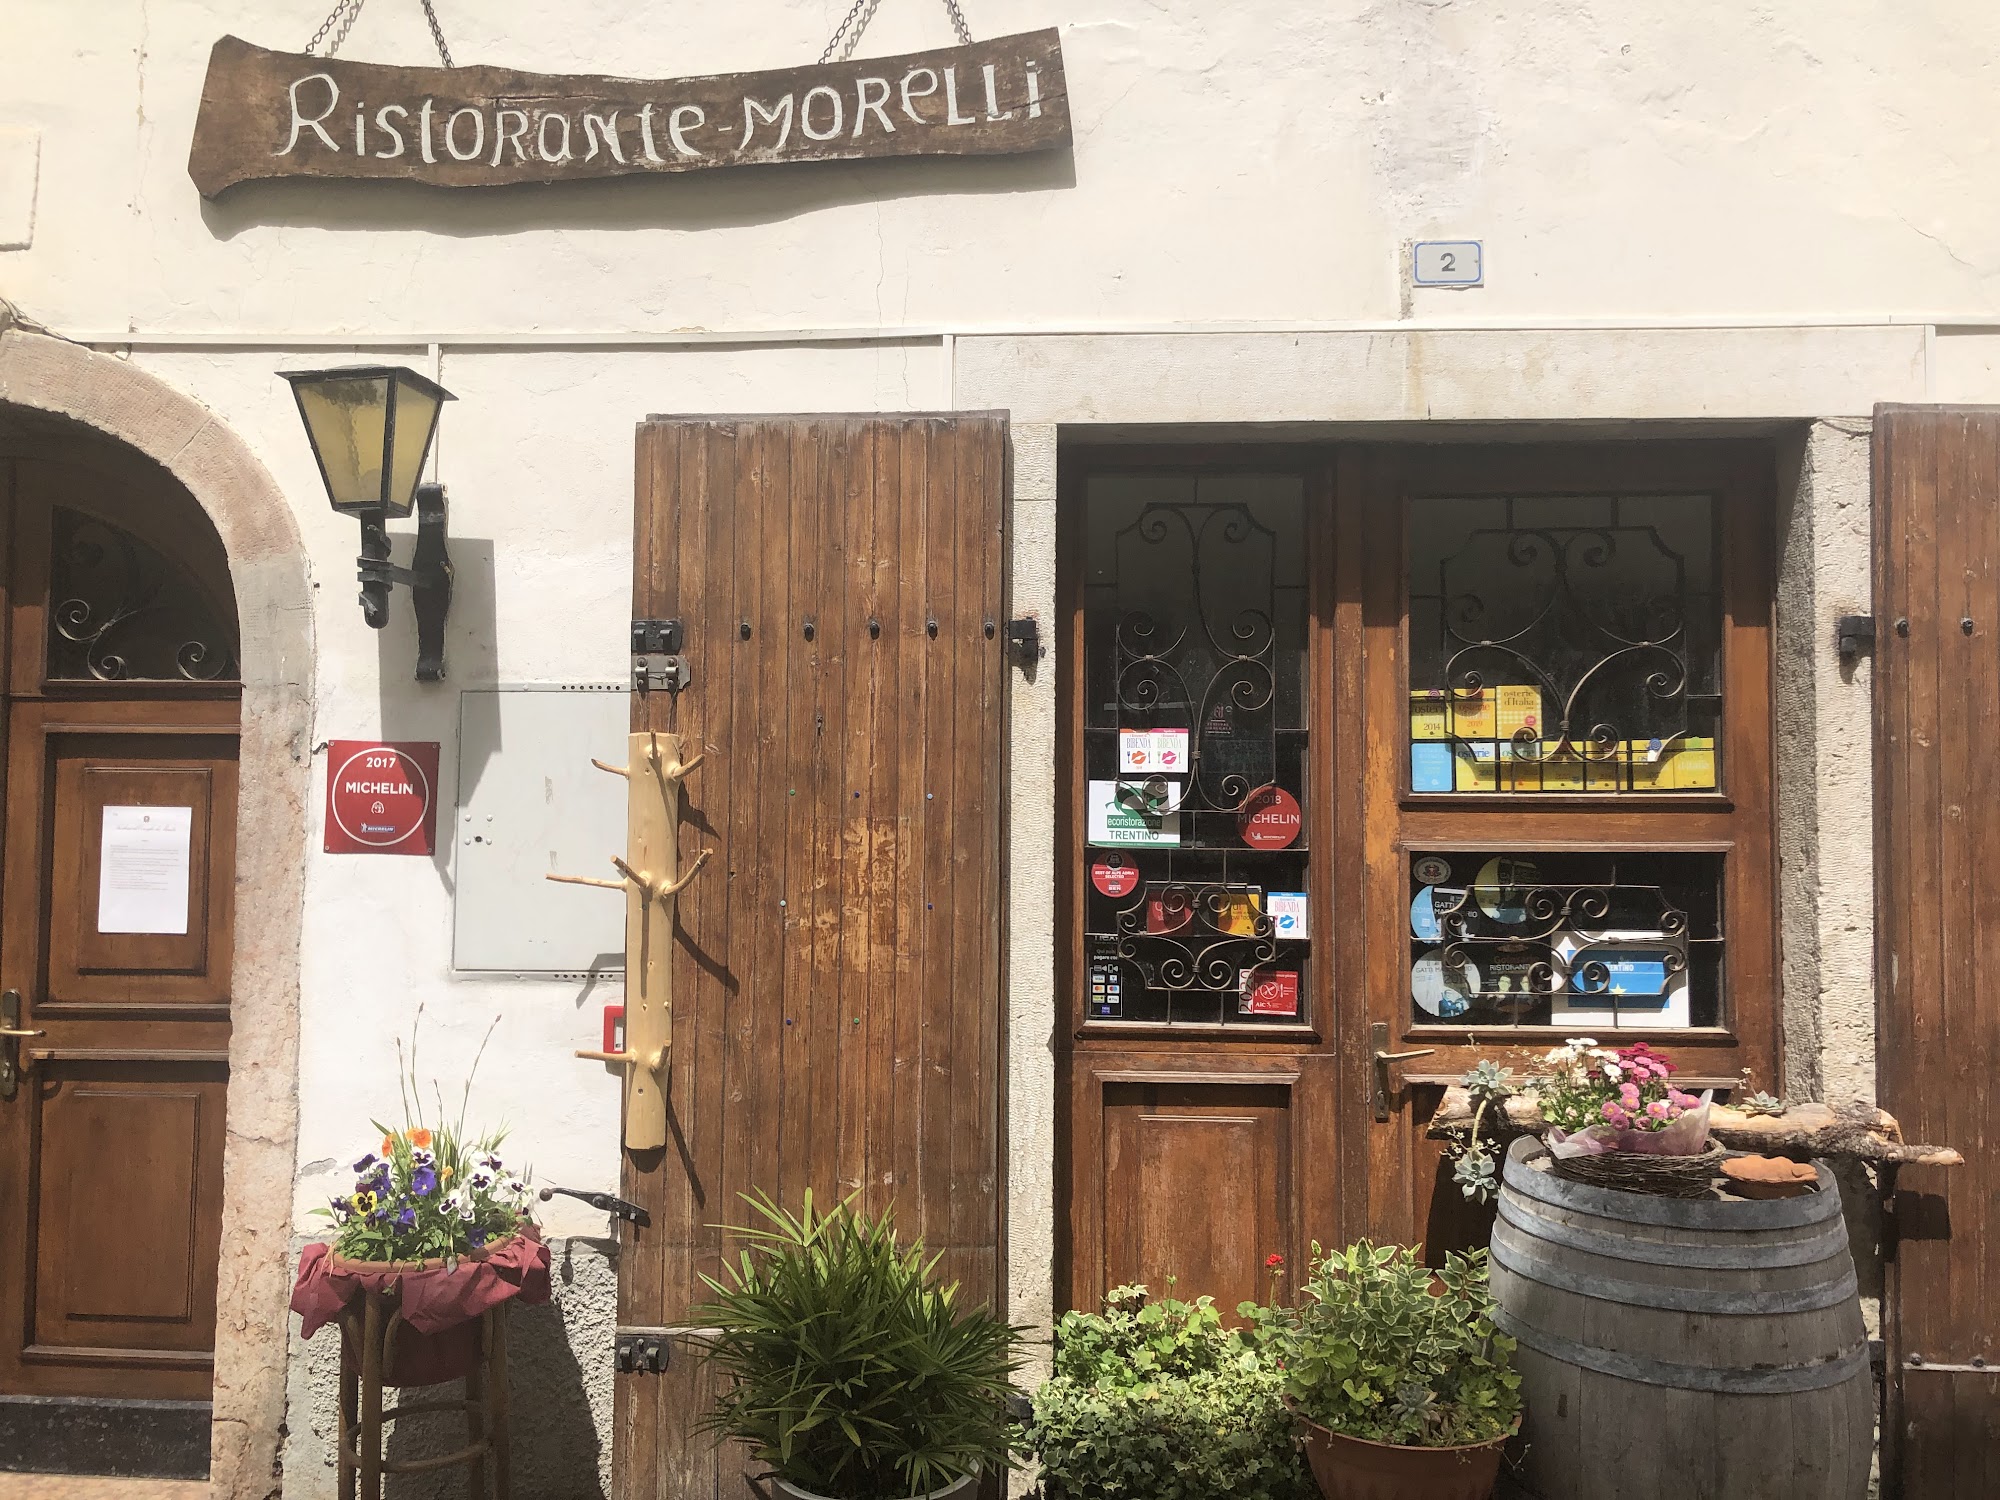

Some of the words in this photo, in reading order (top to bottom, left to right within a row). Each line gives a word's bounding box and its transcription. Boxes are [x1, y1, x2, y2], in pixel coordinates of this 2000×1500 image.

[1440, 252, 1456, 272] 2
[1423, 723, 1441, 731] 2014
[1126, 737, 1151, 748] BIBENDA
[366, 757, 397, 768] 2017
[345, 781, 414, 795] MICHELIN
[1255, 795, 1282, 804] 2018
[1237, 813, 1300, 824] MICHELIN
[1109, 830, 1159, 840] TRENTINO
[1274, 902, 1300, 913] BIBENDA
